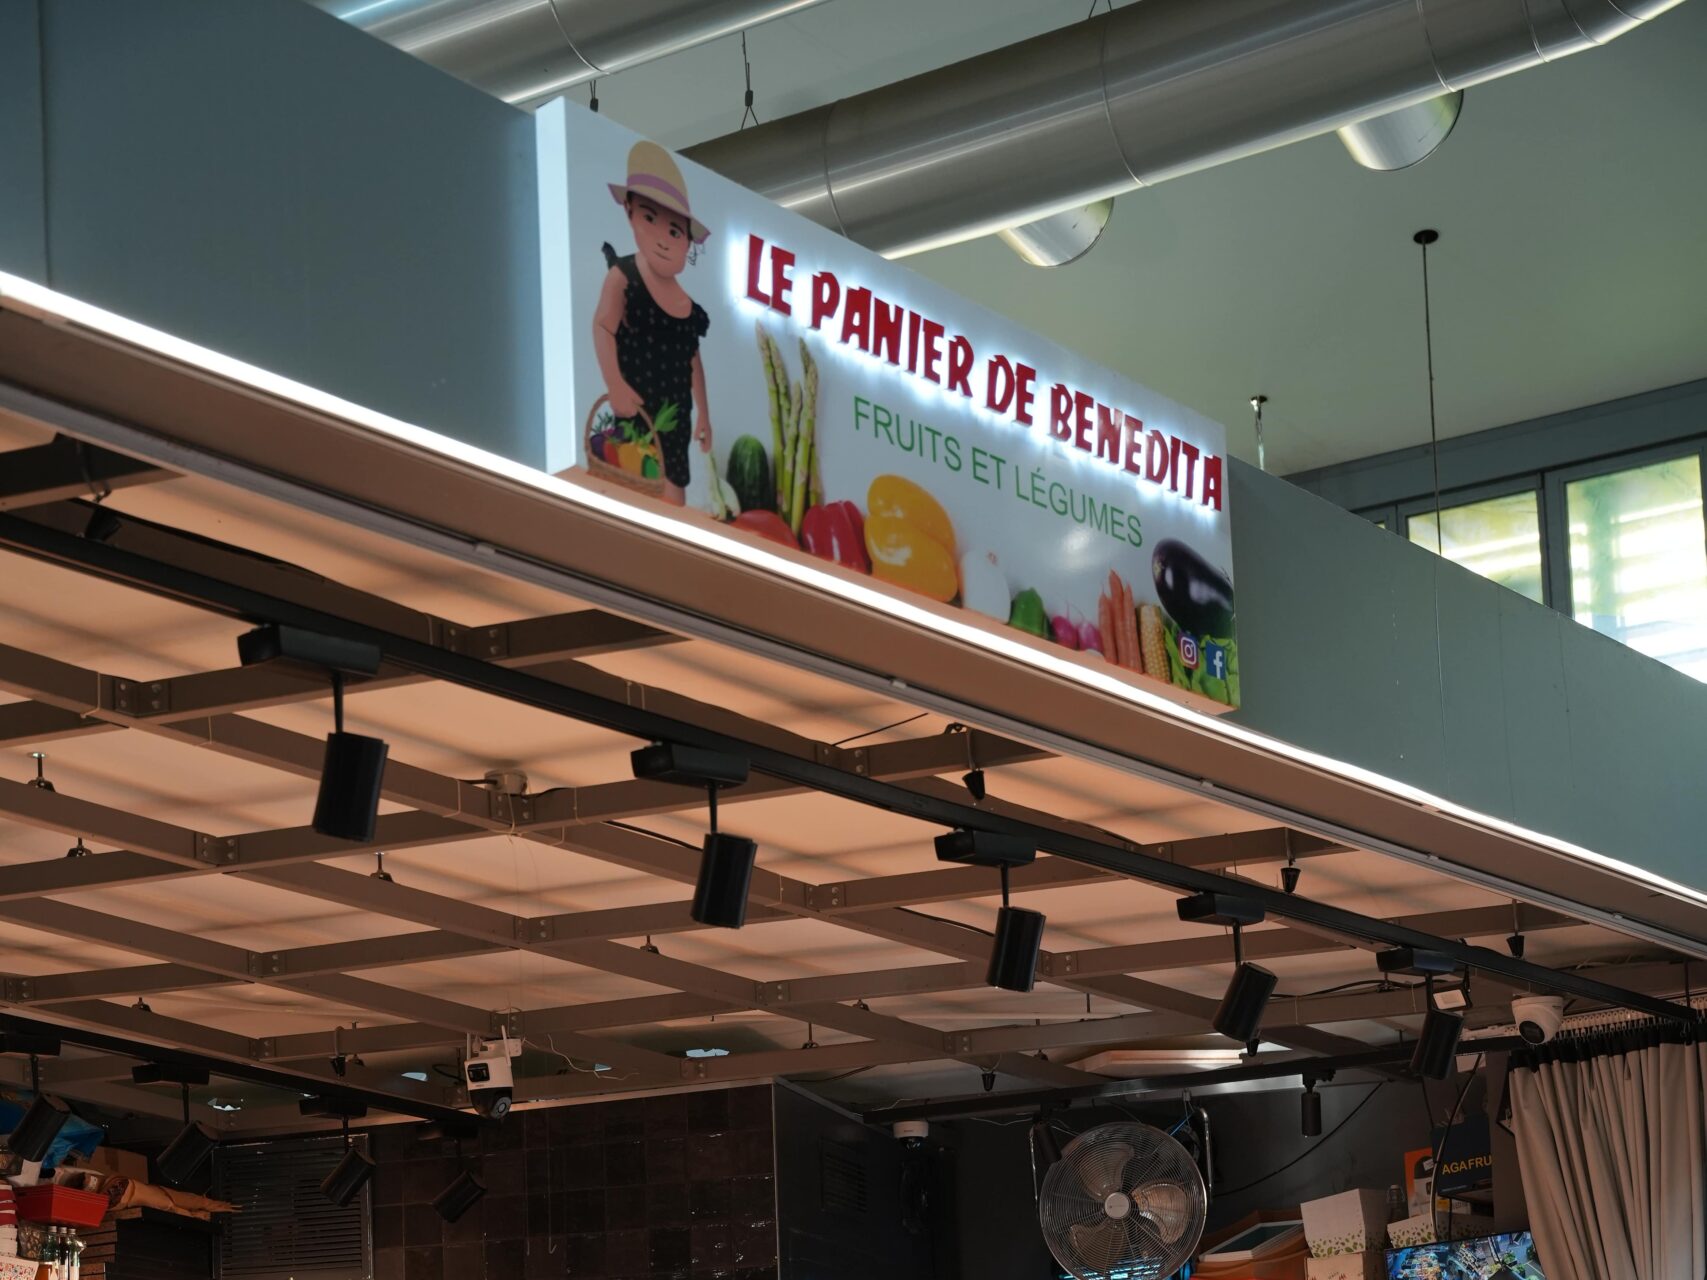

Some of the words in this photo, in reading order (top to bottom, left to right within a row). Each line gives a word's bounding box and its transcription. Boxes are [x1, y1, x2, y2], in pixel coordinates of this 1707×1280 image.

[745, 234, 796, 318] LE
[810, 271, 975, 398] PANIER
[985, 353, 1037, 426] DE
[1050, 383, 1222, 512] BENEDITA
[853, 395, 963, 473] FRUITS
[971, 446, 1006, 490] ET
[1015, 463, 1144, 549] LÉGUMES
